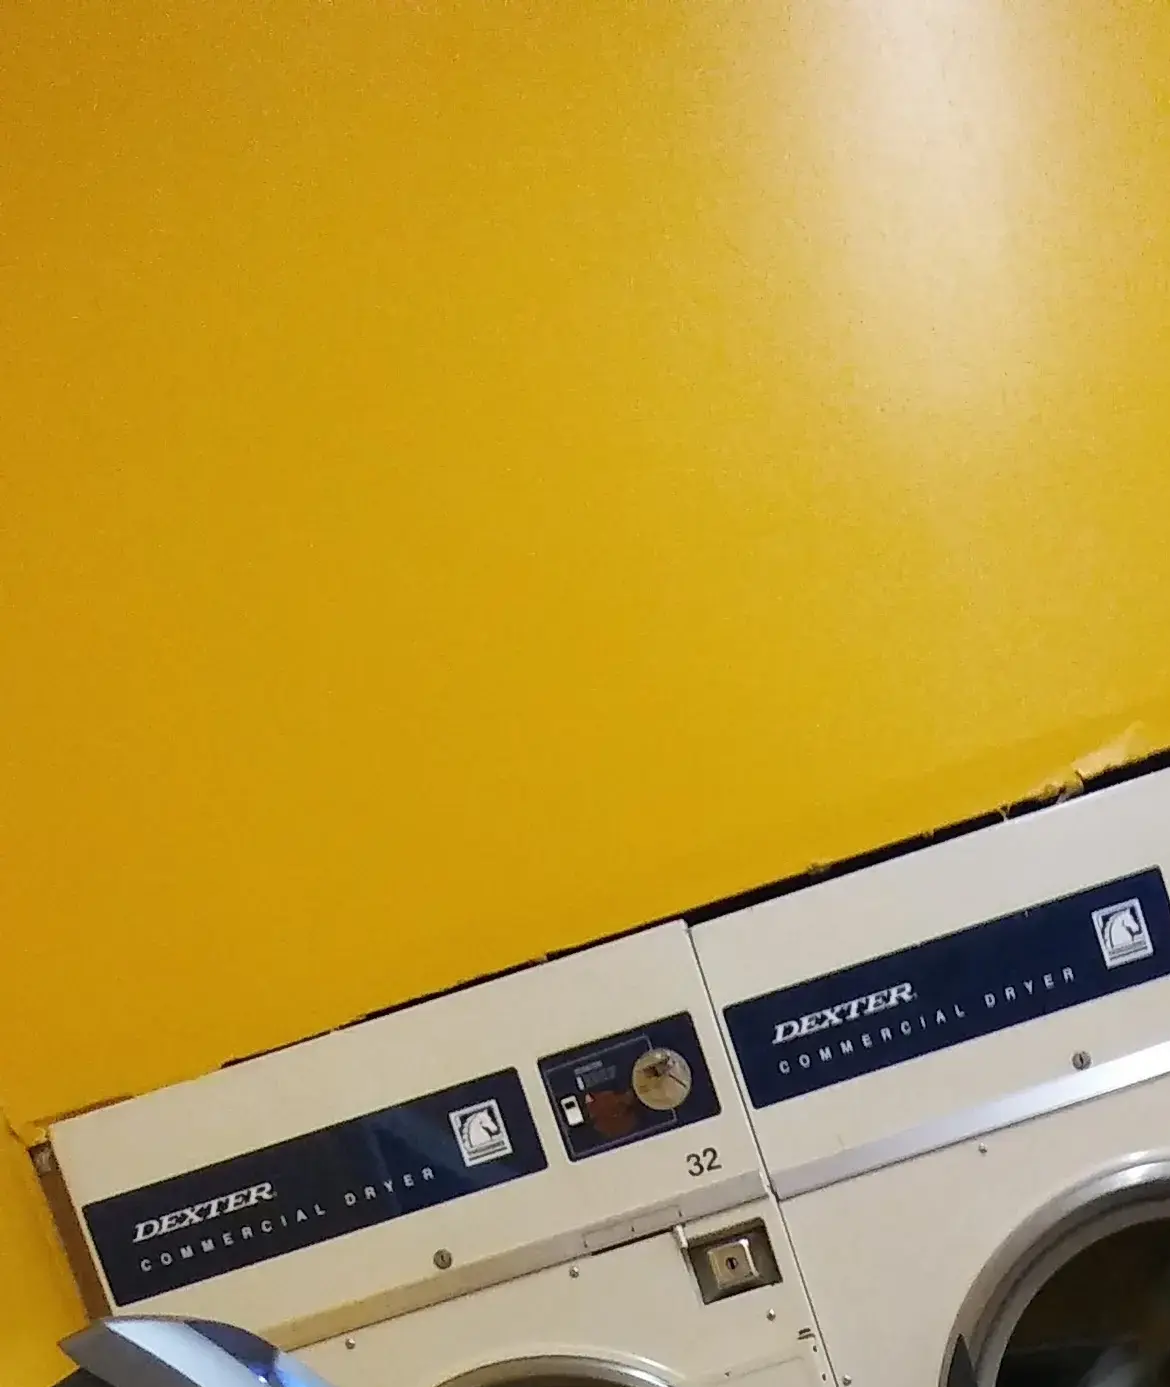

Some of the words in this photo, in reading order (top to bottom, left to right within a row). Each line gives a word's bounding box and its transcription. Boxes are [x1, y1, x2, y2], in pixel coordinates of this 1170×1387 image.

[772, 981, 914, 1044] DEXTER
[778, 1003, 965, 1074] COMMERCIAL
[984, 966, 1076, 1008] DRYER
[686, 1147, 722, 1176] 32
[132, 1181, 275, 1243] DEXTER
[140, 1203, 327, 1272] COMMERCIAL
[344, 1166, 435, 1206] DRYER
